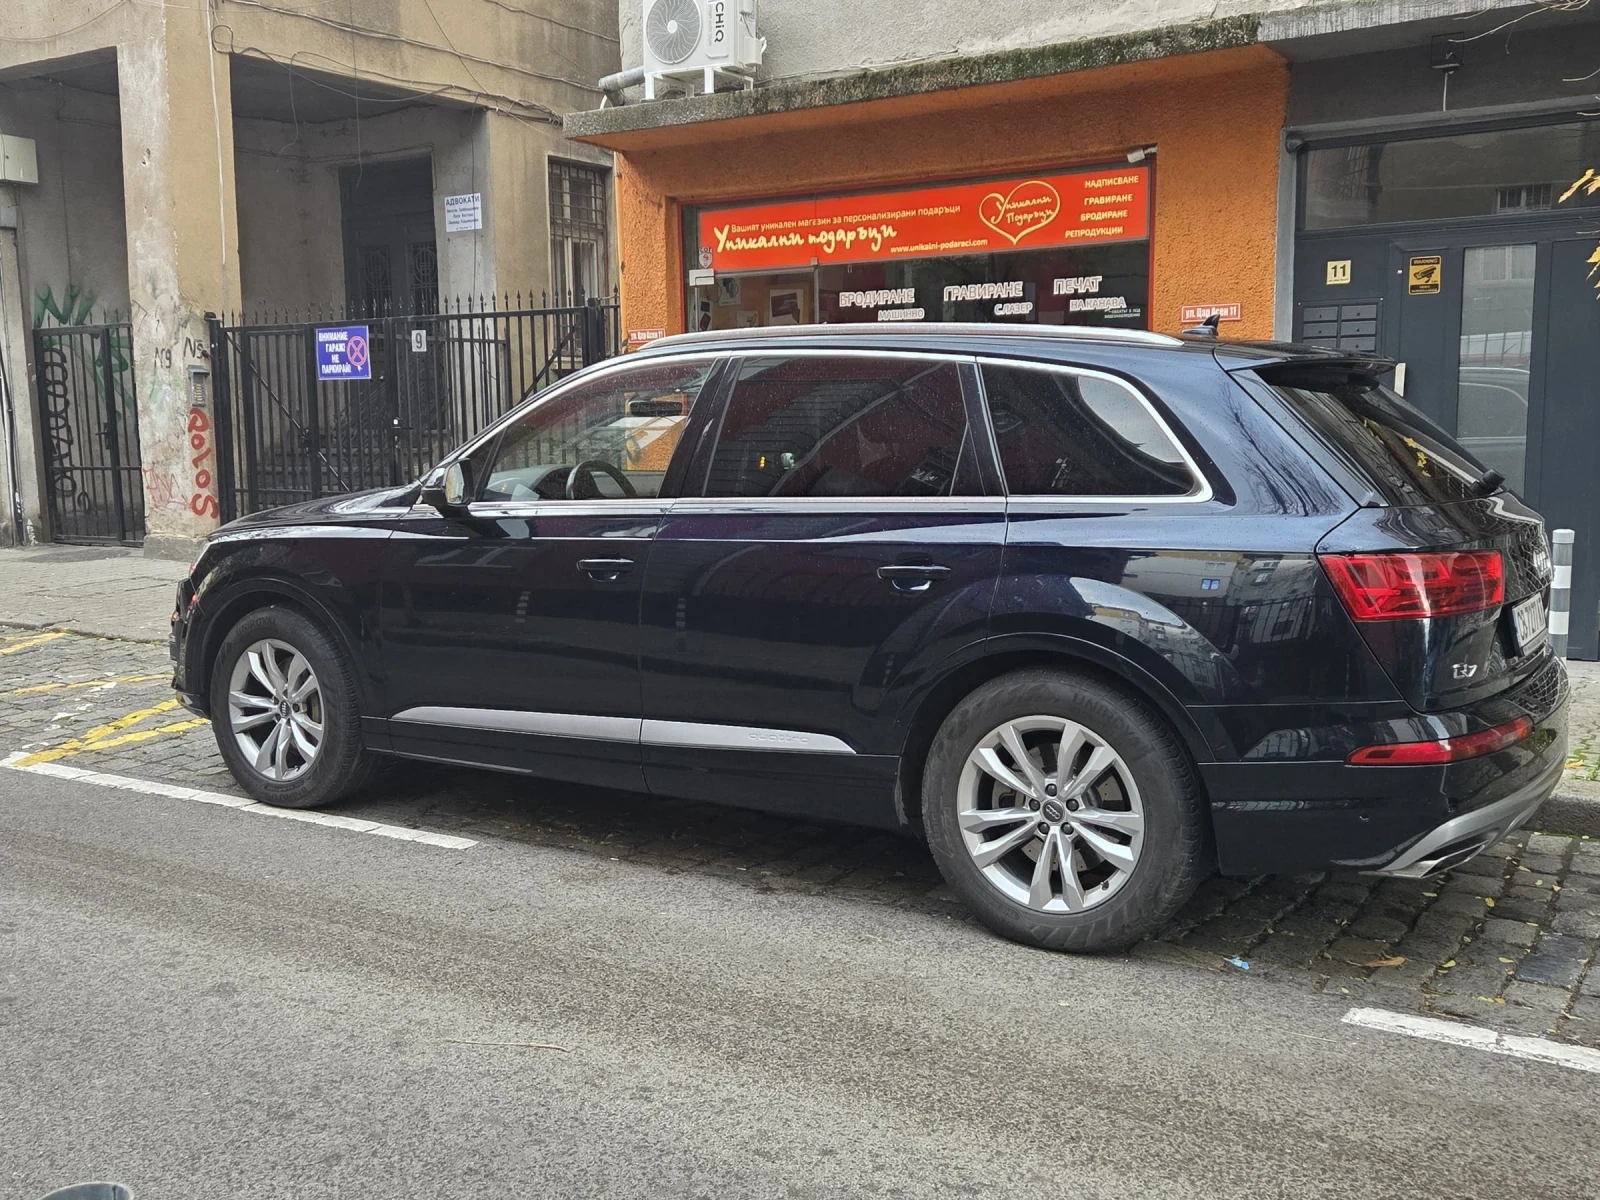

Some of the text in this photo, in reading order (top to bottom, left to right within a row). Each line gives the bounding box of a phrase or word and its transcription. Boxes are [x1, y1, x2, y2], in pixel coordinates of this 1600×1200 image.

[1084, 175, 1139, 188] НАДПИСВАНЕ
[446, 195, 479, 206] АДВОКАТИ
[1084, 193, 1133, 206] ГРАВИРАНЕ
[731, 205, 961, 233] Вашият уникален магазин за персонализирани подаръци
[1080, 210, 1128, 222] БРОДИРАНЕ
[713, 224, 897, 253] Уникални подаръци
[1065, 226, 1123, 239] РЕПРОДУКЦИИ
[1330, 264, 1347, 278] 11
[943, 281, 1023, 302] ГРАВИРАНЕ
[1053, 276, 1102, 295] ПЕЧАТ
[839, 288, 915, 308] БРОДИРАНЕ
[1069, 297, 1127, 311] НА КАНАВА
[877, 308, 925, 321] МАШИННО
[1002, 302, 1033, 315] ЛАЗЕР
[1185, 309, 1195, 319] ул.
[1196, 307, 1210, 319] Цар
[1230, 305, 1237, 316] 11
[318, 331, 348, 342] ВНИМАНИЕ
[415, 333, 423, 349] 9
[331, 354, 340, 364] НЕ
